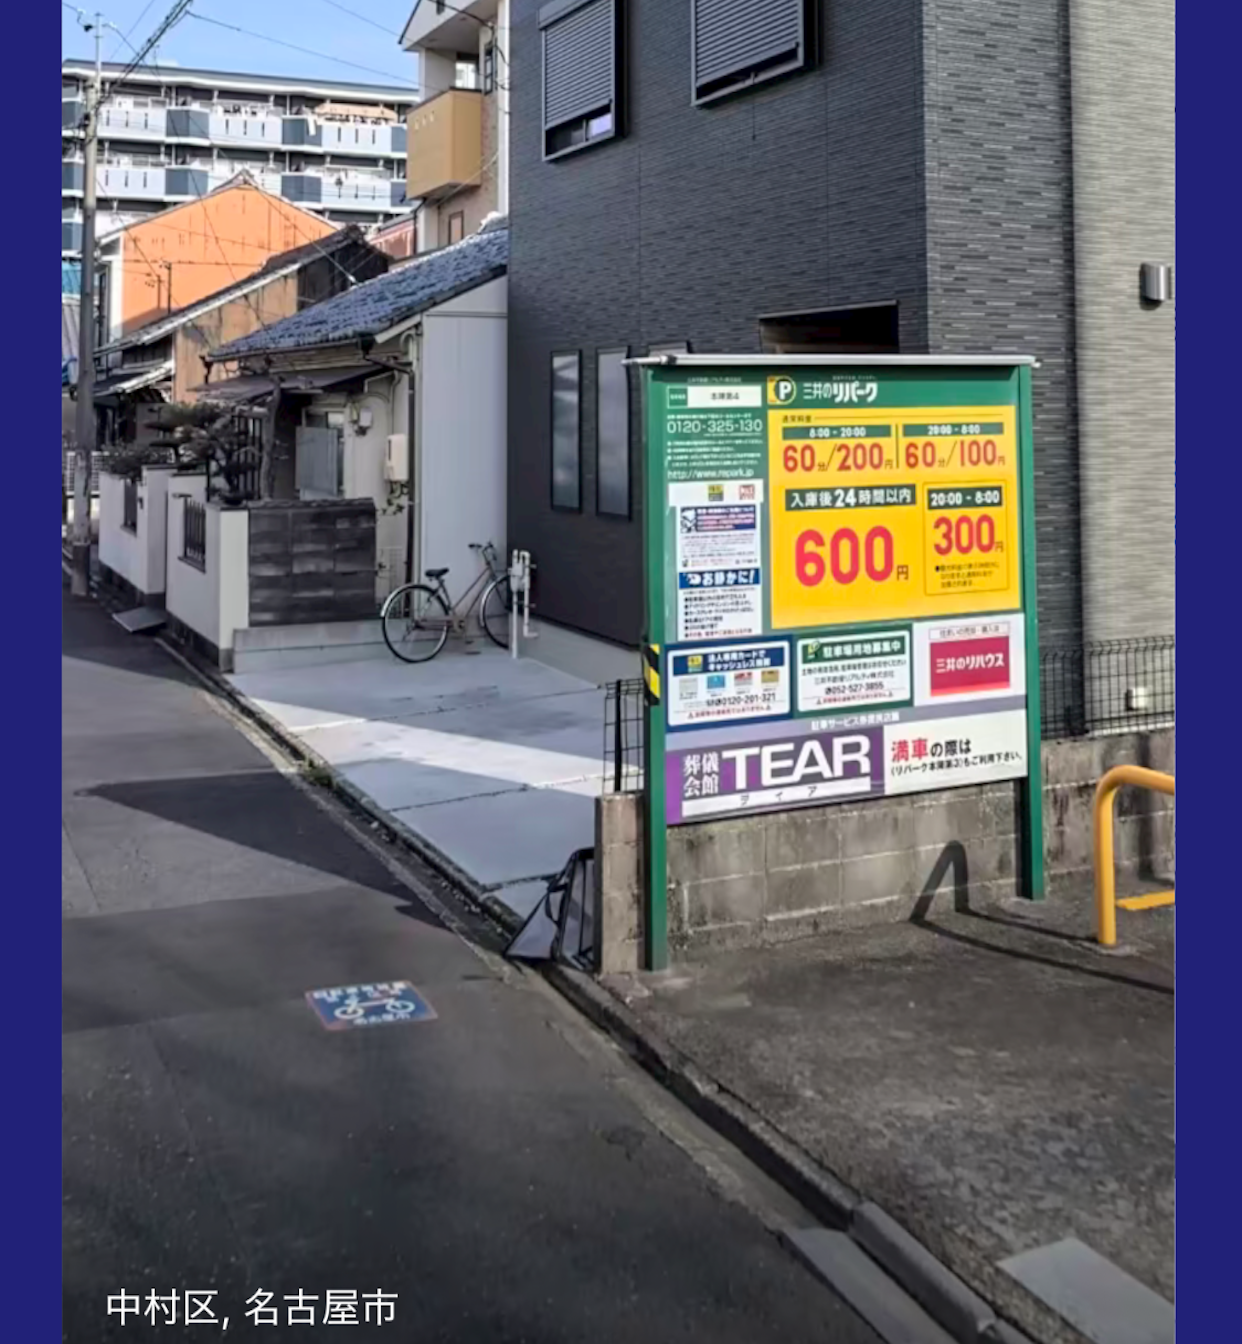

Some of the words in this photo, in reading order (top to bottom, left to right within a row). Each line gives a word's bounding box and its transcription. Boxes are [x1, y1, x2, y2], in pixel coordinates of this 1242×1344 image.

[803, 381, 878, 403] 三井のリパーク
[667, 418, 763, 434] 0120-325-130
[809, 427, 830, 438] 8:00
[840, 426, 867, 437] 20:00
[927, 424, 953, 435] 20:00
[790, 488, 912, 508] 入庫後24時間以内
[930, 492, 963, 506] 20:00
[975, 490, 1000, 504] 8:00
[933, 513, 1004, 556] 300円
[795, 525, 909, 587] 600円
[936, 652, 1005, 674] 三井のリハウス
[891, 738, 971, 763] 満車の際は
[683, 751, 719, 777] 葬儀
[721, 734, 871, 790] TEAR
[684, 773, 719, 798] 会館
